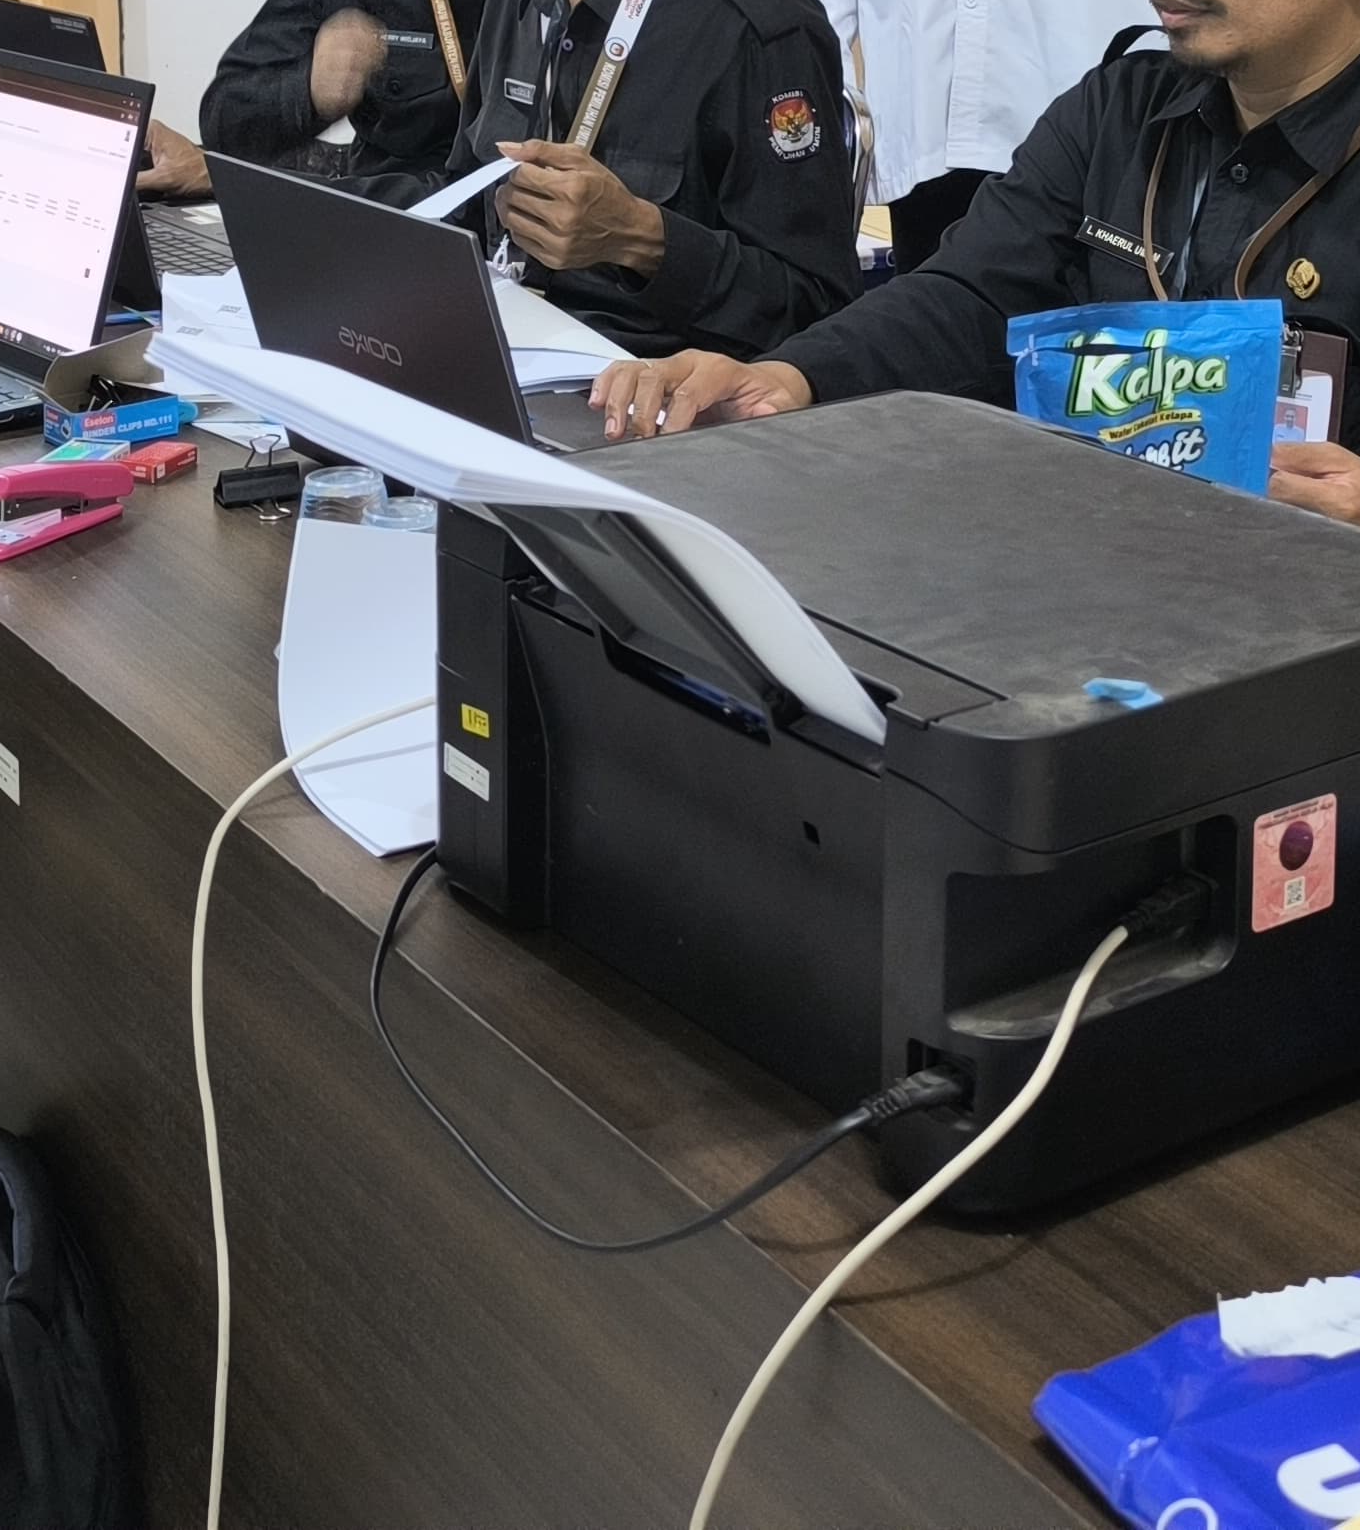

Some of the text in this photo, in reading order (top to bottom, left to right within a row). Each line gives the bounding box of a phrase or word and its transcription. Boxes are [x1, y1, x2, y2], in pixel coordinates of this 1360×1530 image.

[772, 90, 803, 104] KOMISI
[1095, 228, 1134, 253] KHAERUL
[1068, 329, 1227, 416] Kalpa
[84, 414, 115, 428] Eselon
[1159, 411, 1193, 422] Kelapa
[82, 426, 116, 439] BINDER
[117, 419, 143, 433] CLIPS
